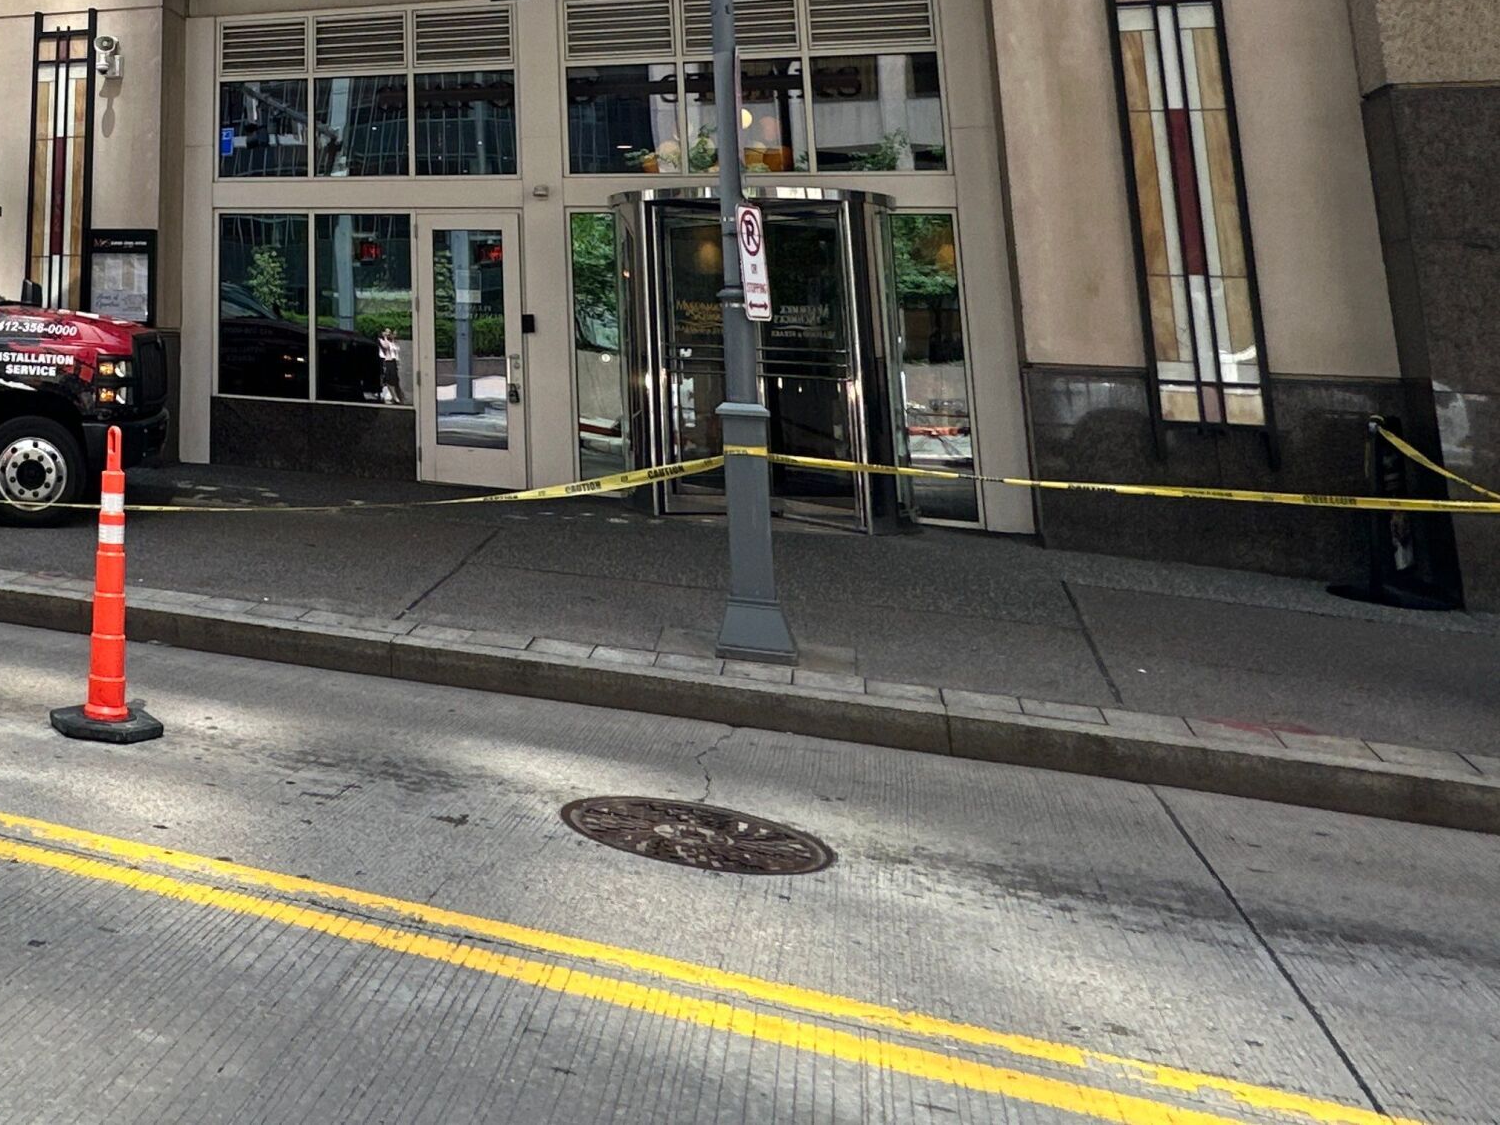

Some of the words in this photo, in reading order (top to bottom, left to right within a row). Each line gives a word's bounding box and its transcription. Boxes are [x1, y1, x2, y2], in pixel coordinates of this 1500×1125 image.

[5, 364, 57, 377] SERVICE
[647, 465, 685, 479] CAUTION
[565, 480, 602, 494] CAUTION
